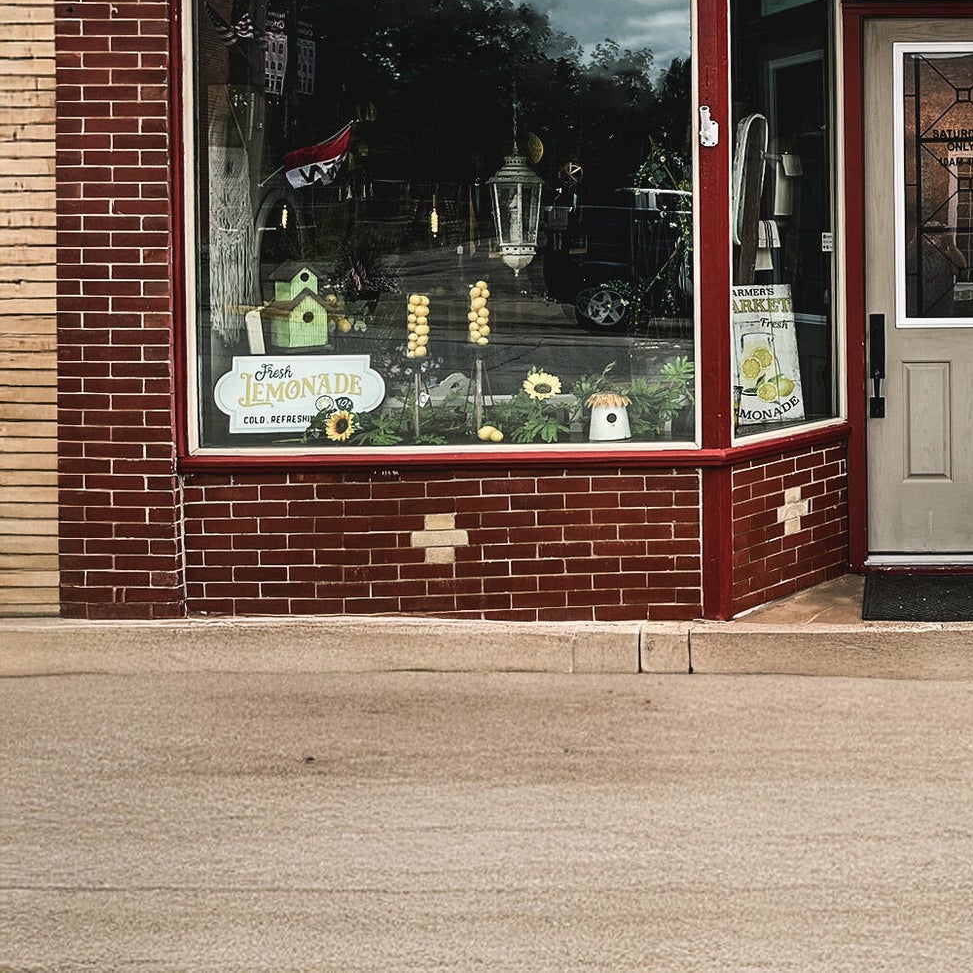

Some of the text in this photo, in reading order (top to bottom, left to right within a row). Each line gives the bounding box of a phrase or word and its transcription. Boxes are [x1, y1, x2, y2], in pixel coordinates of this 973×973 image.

[760, 317, 788, 329] Fresh
[255, 363, 294, 381] Fresh
[238, 372, 362, 407] LEMONADE
